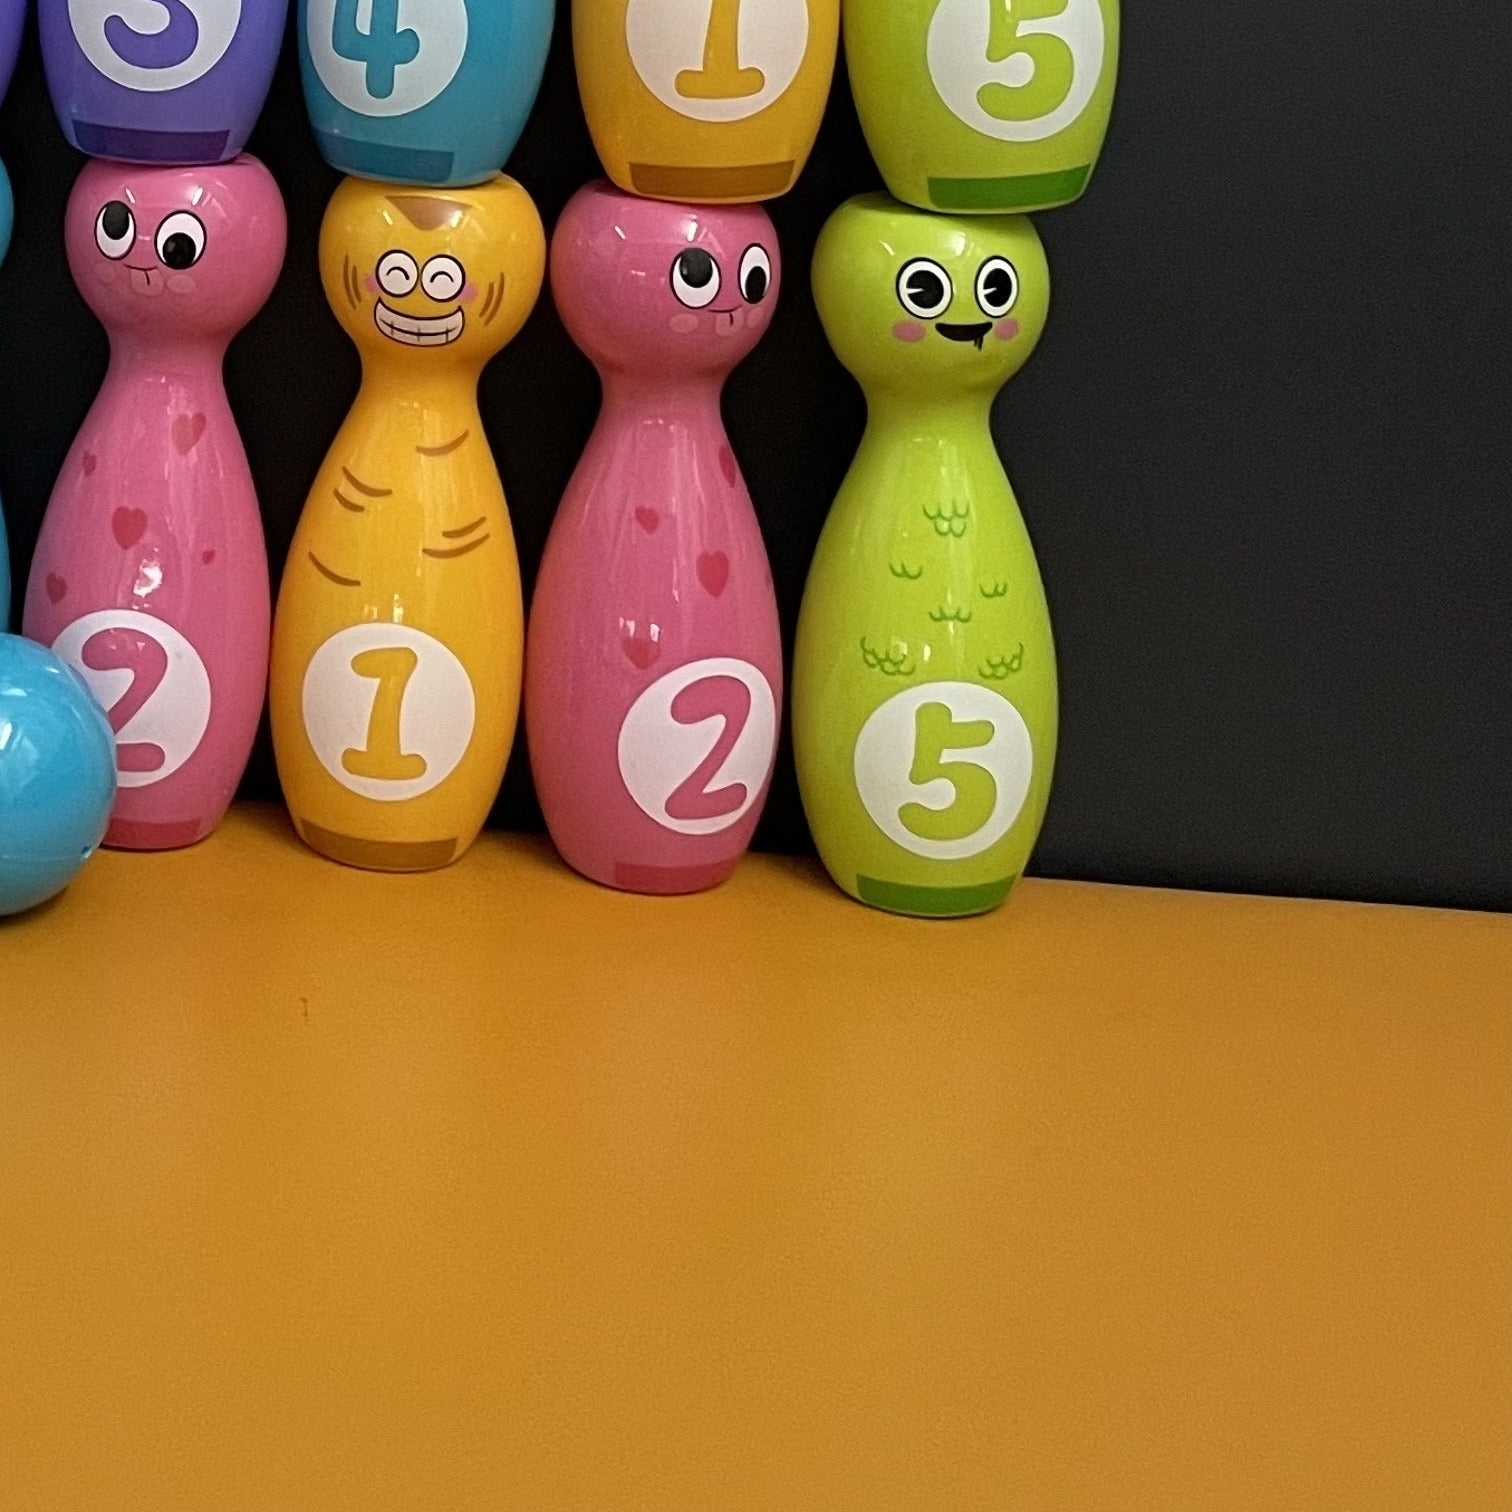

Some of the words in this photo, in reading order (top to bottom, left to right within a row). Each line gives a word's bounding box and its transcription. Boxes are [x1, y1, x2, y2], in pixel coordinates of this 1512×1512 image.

[81, 627, 169, 772] 2
[341, 646, 427, 781] 1
[664, 674, 753, 821] 2
[897, 702, 998, 840] 5
